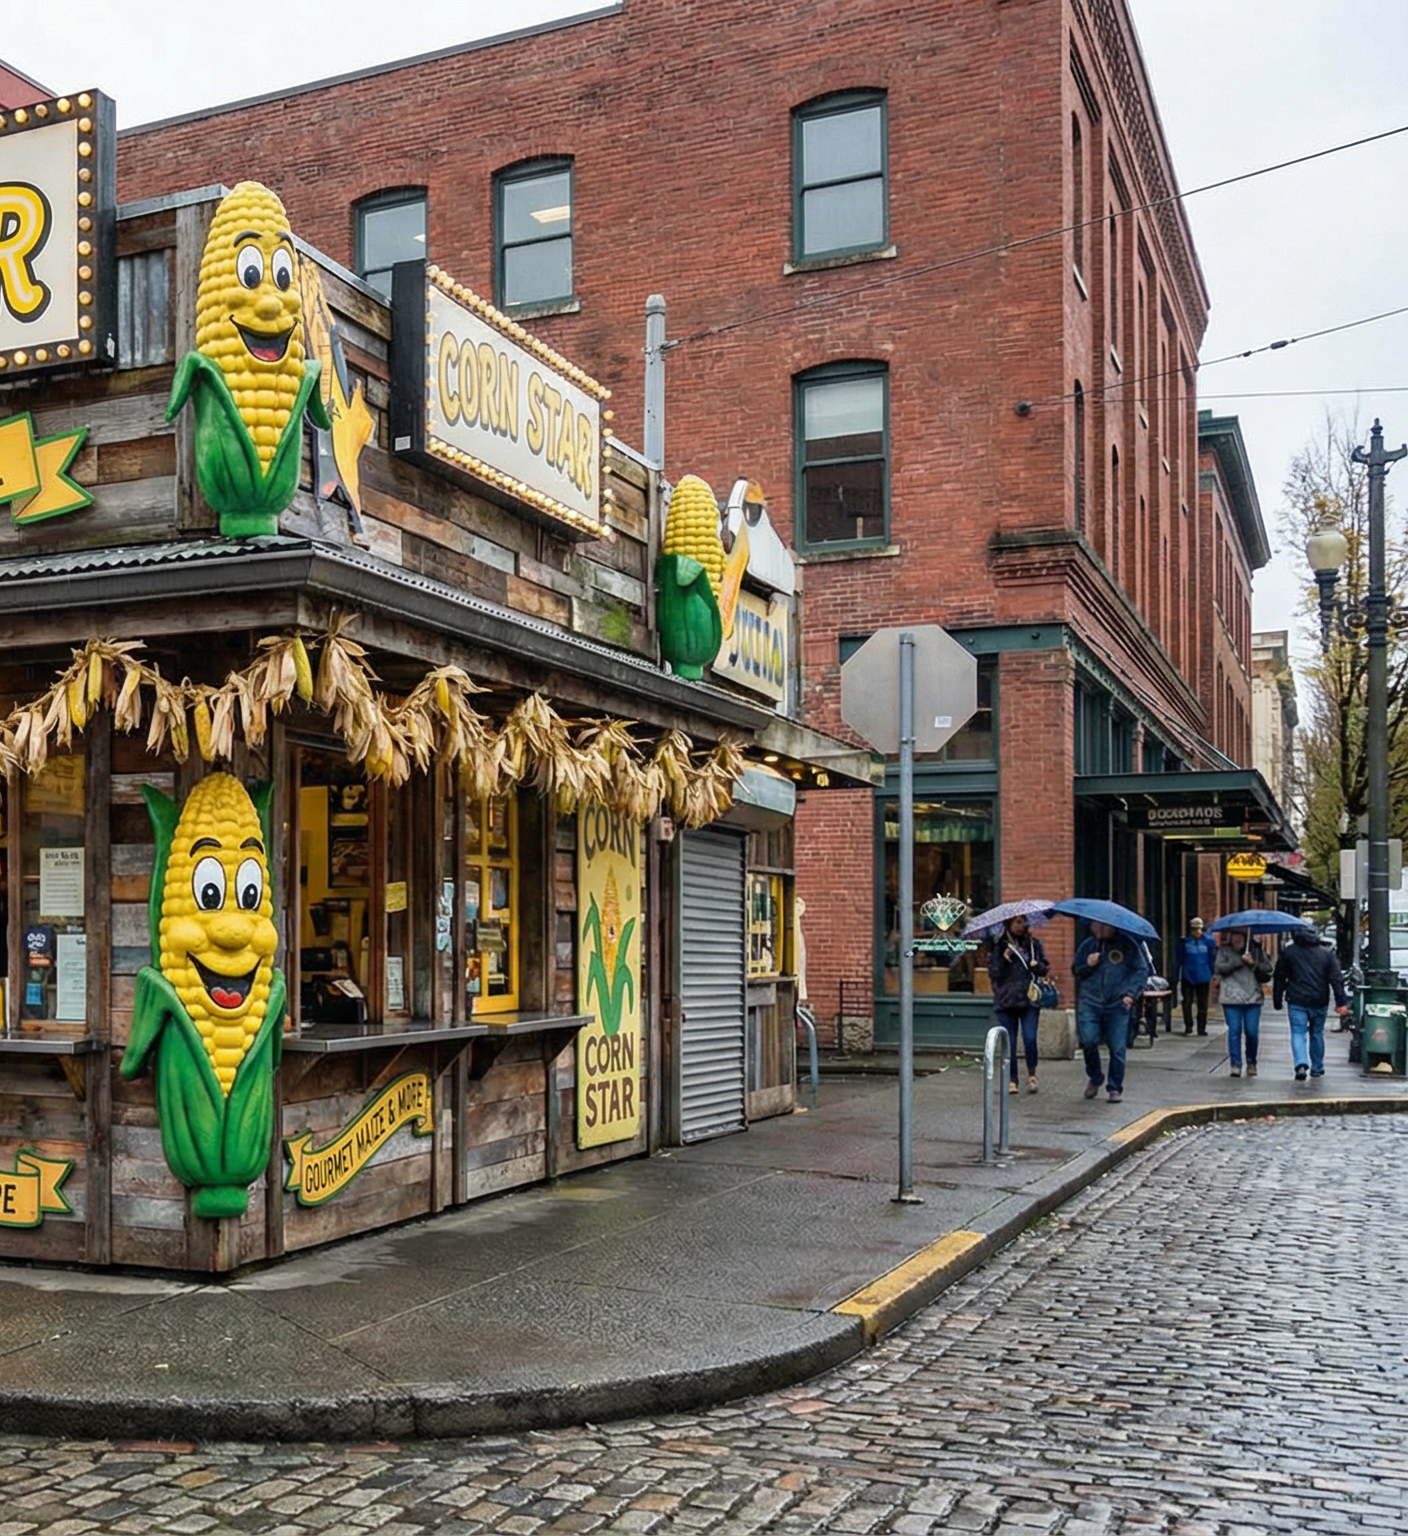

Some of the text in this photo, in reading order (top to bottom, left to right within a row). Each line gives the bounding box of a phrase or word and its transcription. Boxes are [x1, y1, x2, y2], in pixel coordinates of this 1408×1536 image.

[438, 331, 592, 500] CORN STAR
[584, 803, 636, 869] CORN
[585, 1032, 634, 1077] CORN
[585, 1076, 634, 1128] STAR
[305, 1139, 354, 1193] GOURMET
[388, 1099, 396, 1125] &
[398, 1082, 423, 1116] MORE
